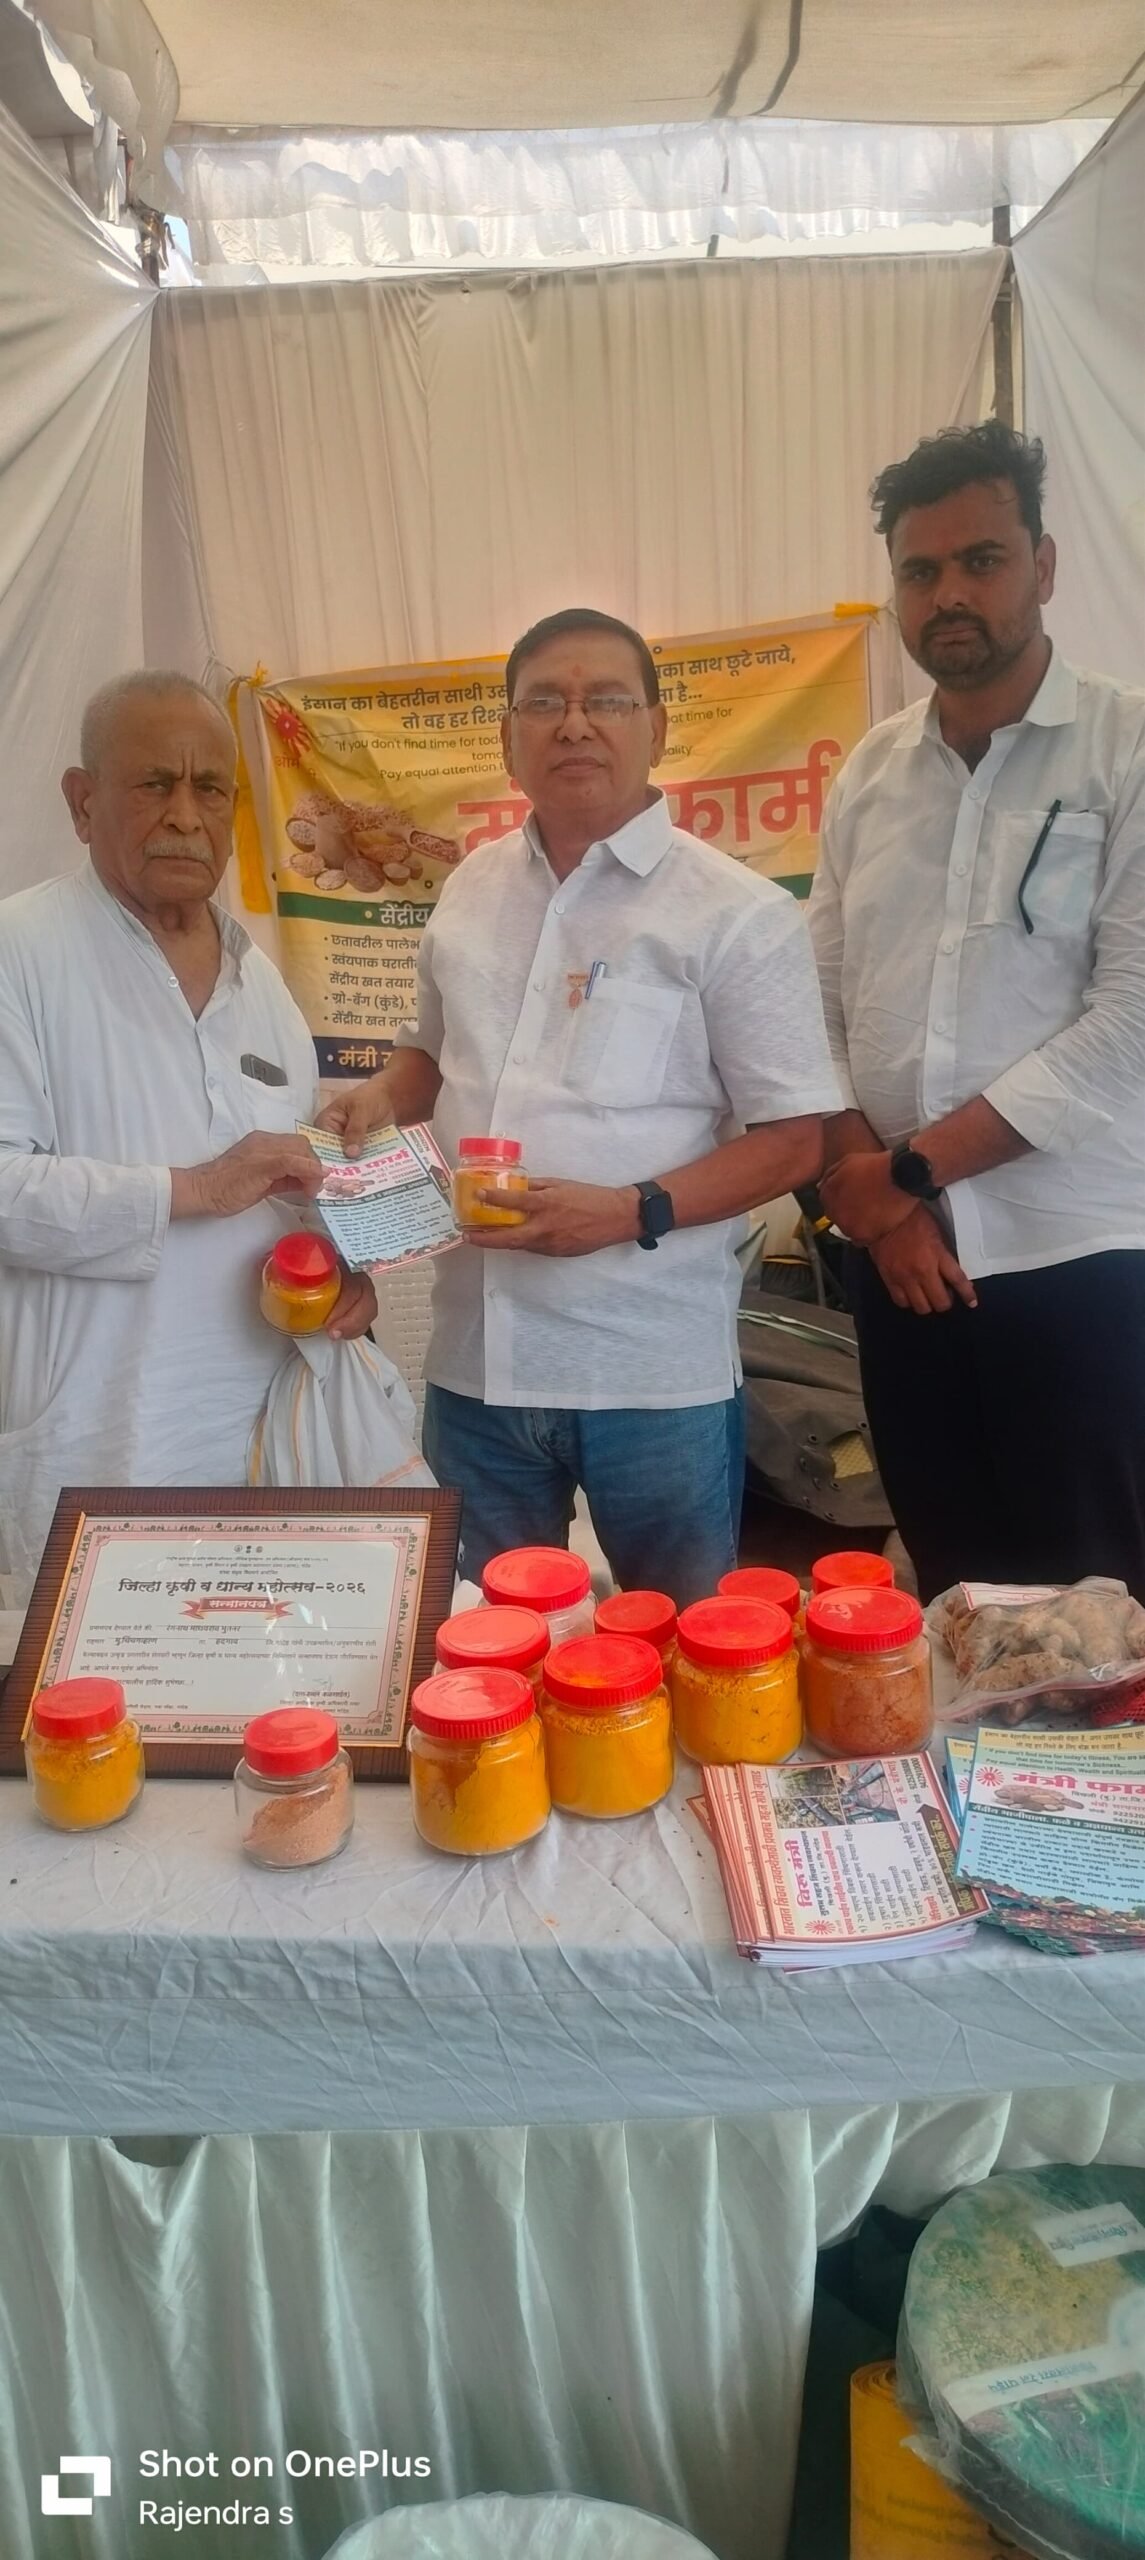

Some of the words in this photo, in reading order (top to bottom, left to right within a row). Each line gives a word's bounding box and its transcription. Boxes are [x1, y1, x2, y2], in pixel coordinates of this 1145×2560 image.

[655, 661, 684, 680] का
[689, 657, 722, 676] साथ
[726, 649, 753, 677] छूटे
[755, 644, 796, 666] जाये,
[301, 694, 346, 712] इंसान
[351, 695, 373, 711] का
[377, 687, 440, 711] बेहतरीन
[442, 682, 483, 704] साथी
[487, 685, 507, 701] उस
[402, 711, 420, 730] तो
[425, 713, 444, 730] वह
[449, 711, 469, 729] हर
[686, 710, 713, 723] time
[717, 706, 733, 719] for
[350, 738, 368, 753] you
[371, 738, 401, 750] don't
[404, 736, 426, 750] find
[430, 736, 456, 749] time
[459, 736, 475, 748] for
[380, 769, 400, 782] Pay
[405, 767, 439, 781] equal
[442, 763, 497, 777] attention
[386, 936, 420, 950] पालेभ
[382, 954, 417, 970] घराती
[361, 976, 382, 988] खत
[385, 978, 414, 990] तयार
[365, 1015, 386, 1027] खत
[338, 1046, 378, 1069] मंत्री
[118, 1577, 162, 1593] जिल्हा
[166, 1578, 196, 1597] कृषी
[200, 1581, 212, 1592] व
[216, 1581, 254, 1593] धान्य
[1012, 1770, 1079, 1789] मंत्री
[784, 1840, 803, 1870] मंत्री
